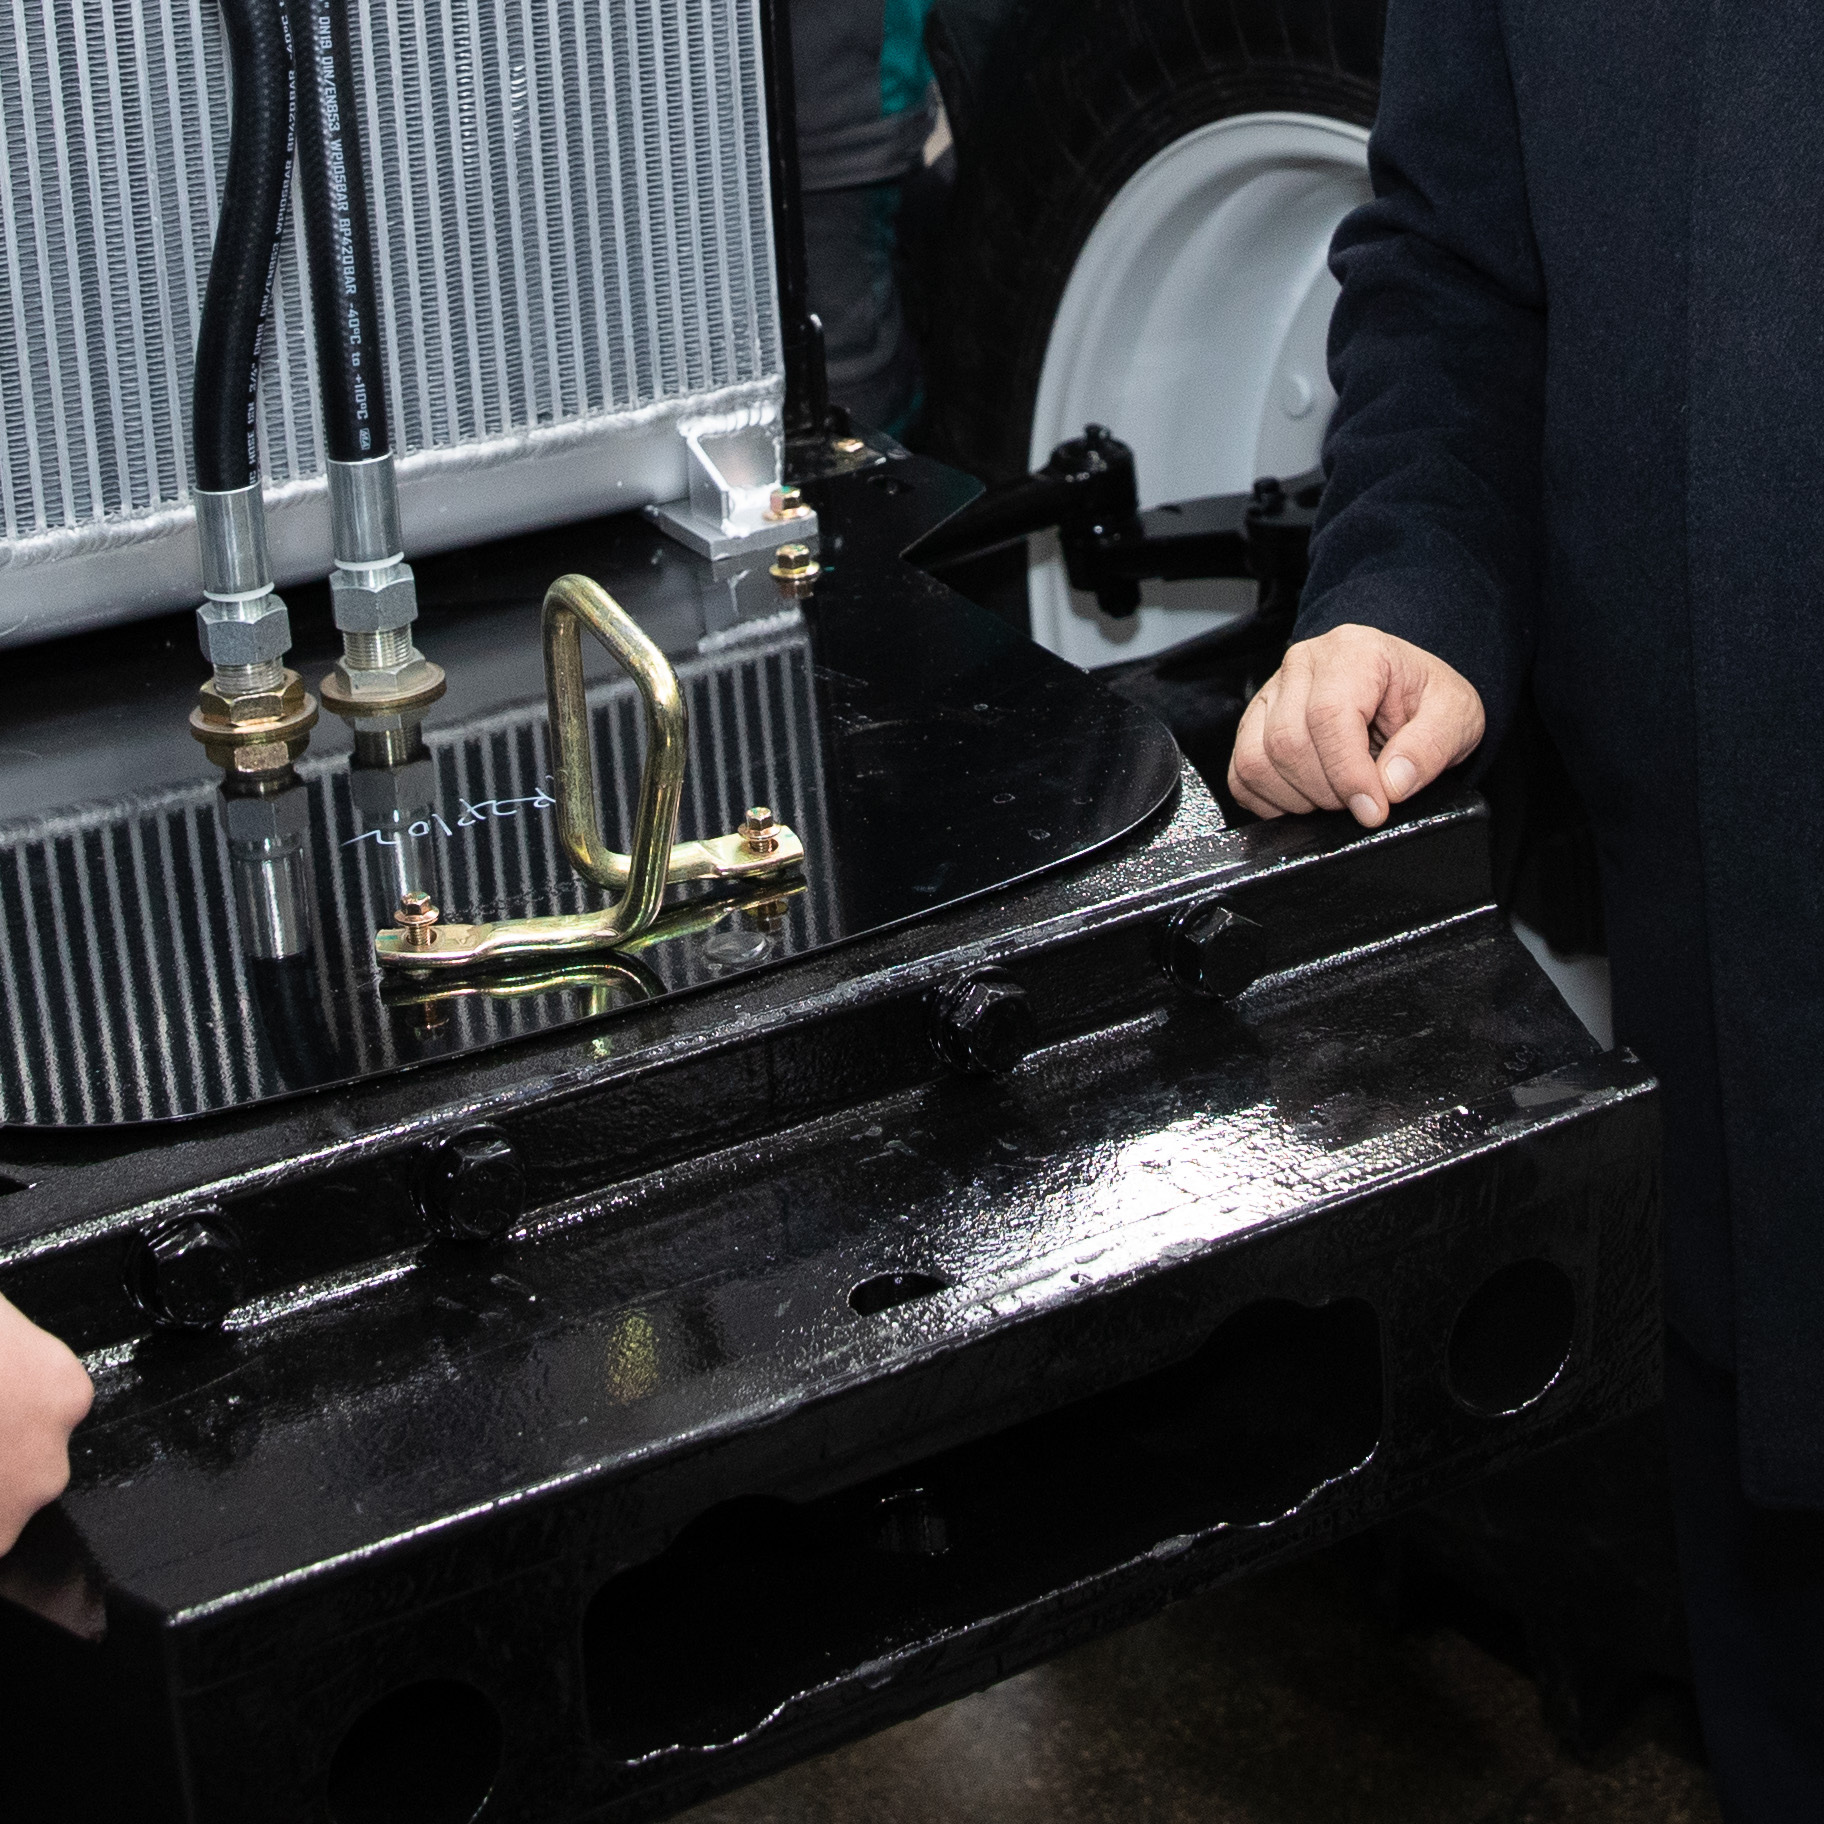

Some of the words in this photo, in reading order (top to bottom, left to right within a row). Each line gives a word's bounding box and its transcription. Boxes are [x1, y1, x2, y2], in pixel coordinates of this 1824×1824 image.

[318, 16, 333, 49] DN19
[321, 56, 341, 132] DIN/EN853
[339, 217, 357, 295] BP420BAR
